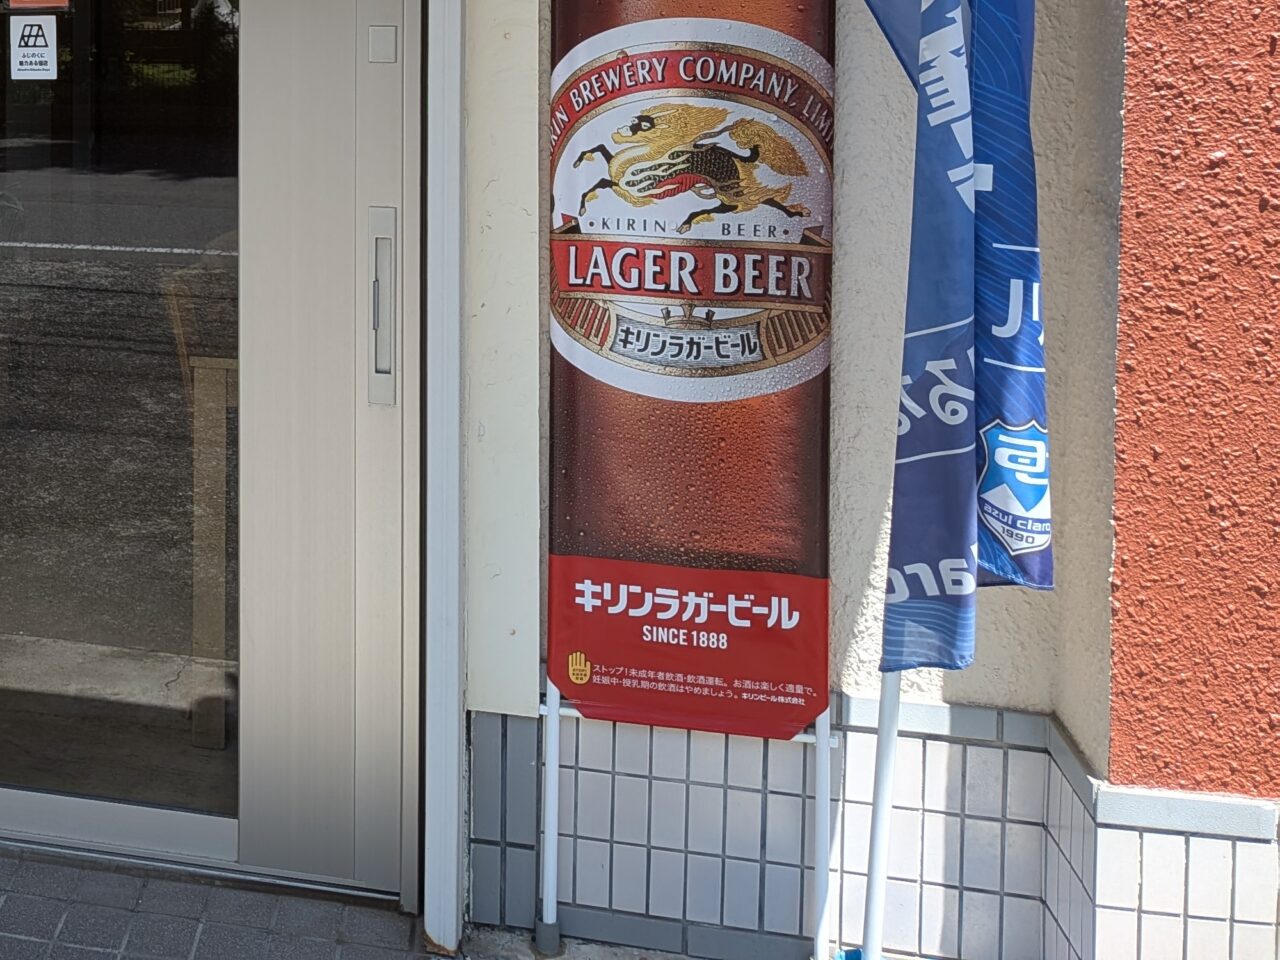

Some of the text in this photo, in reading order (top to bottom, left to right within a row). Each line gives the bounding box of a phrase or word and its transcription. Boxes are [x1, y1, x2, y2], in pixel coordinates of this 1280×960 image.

[570, 57, 666, 112] BREWERY
[678, 56, 799, 107] COMPANY,
[601, 217, 777, 238] KIRIN BEER
[568, 245, 813, 299] LAGER BEER
[618, 326, 758, 361] キリンラガービール
[984, 502, 1013, 525] azul
[1000, 525, 1036, 545] 1990
[575, 579, 800, 629] キリンラガービール
[642, 625, 728, 650] SINCE 1888
